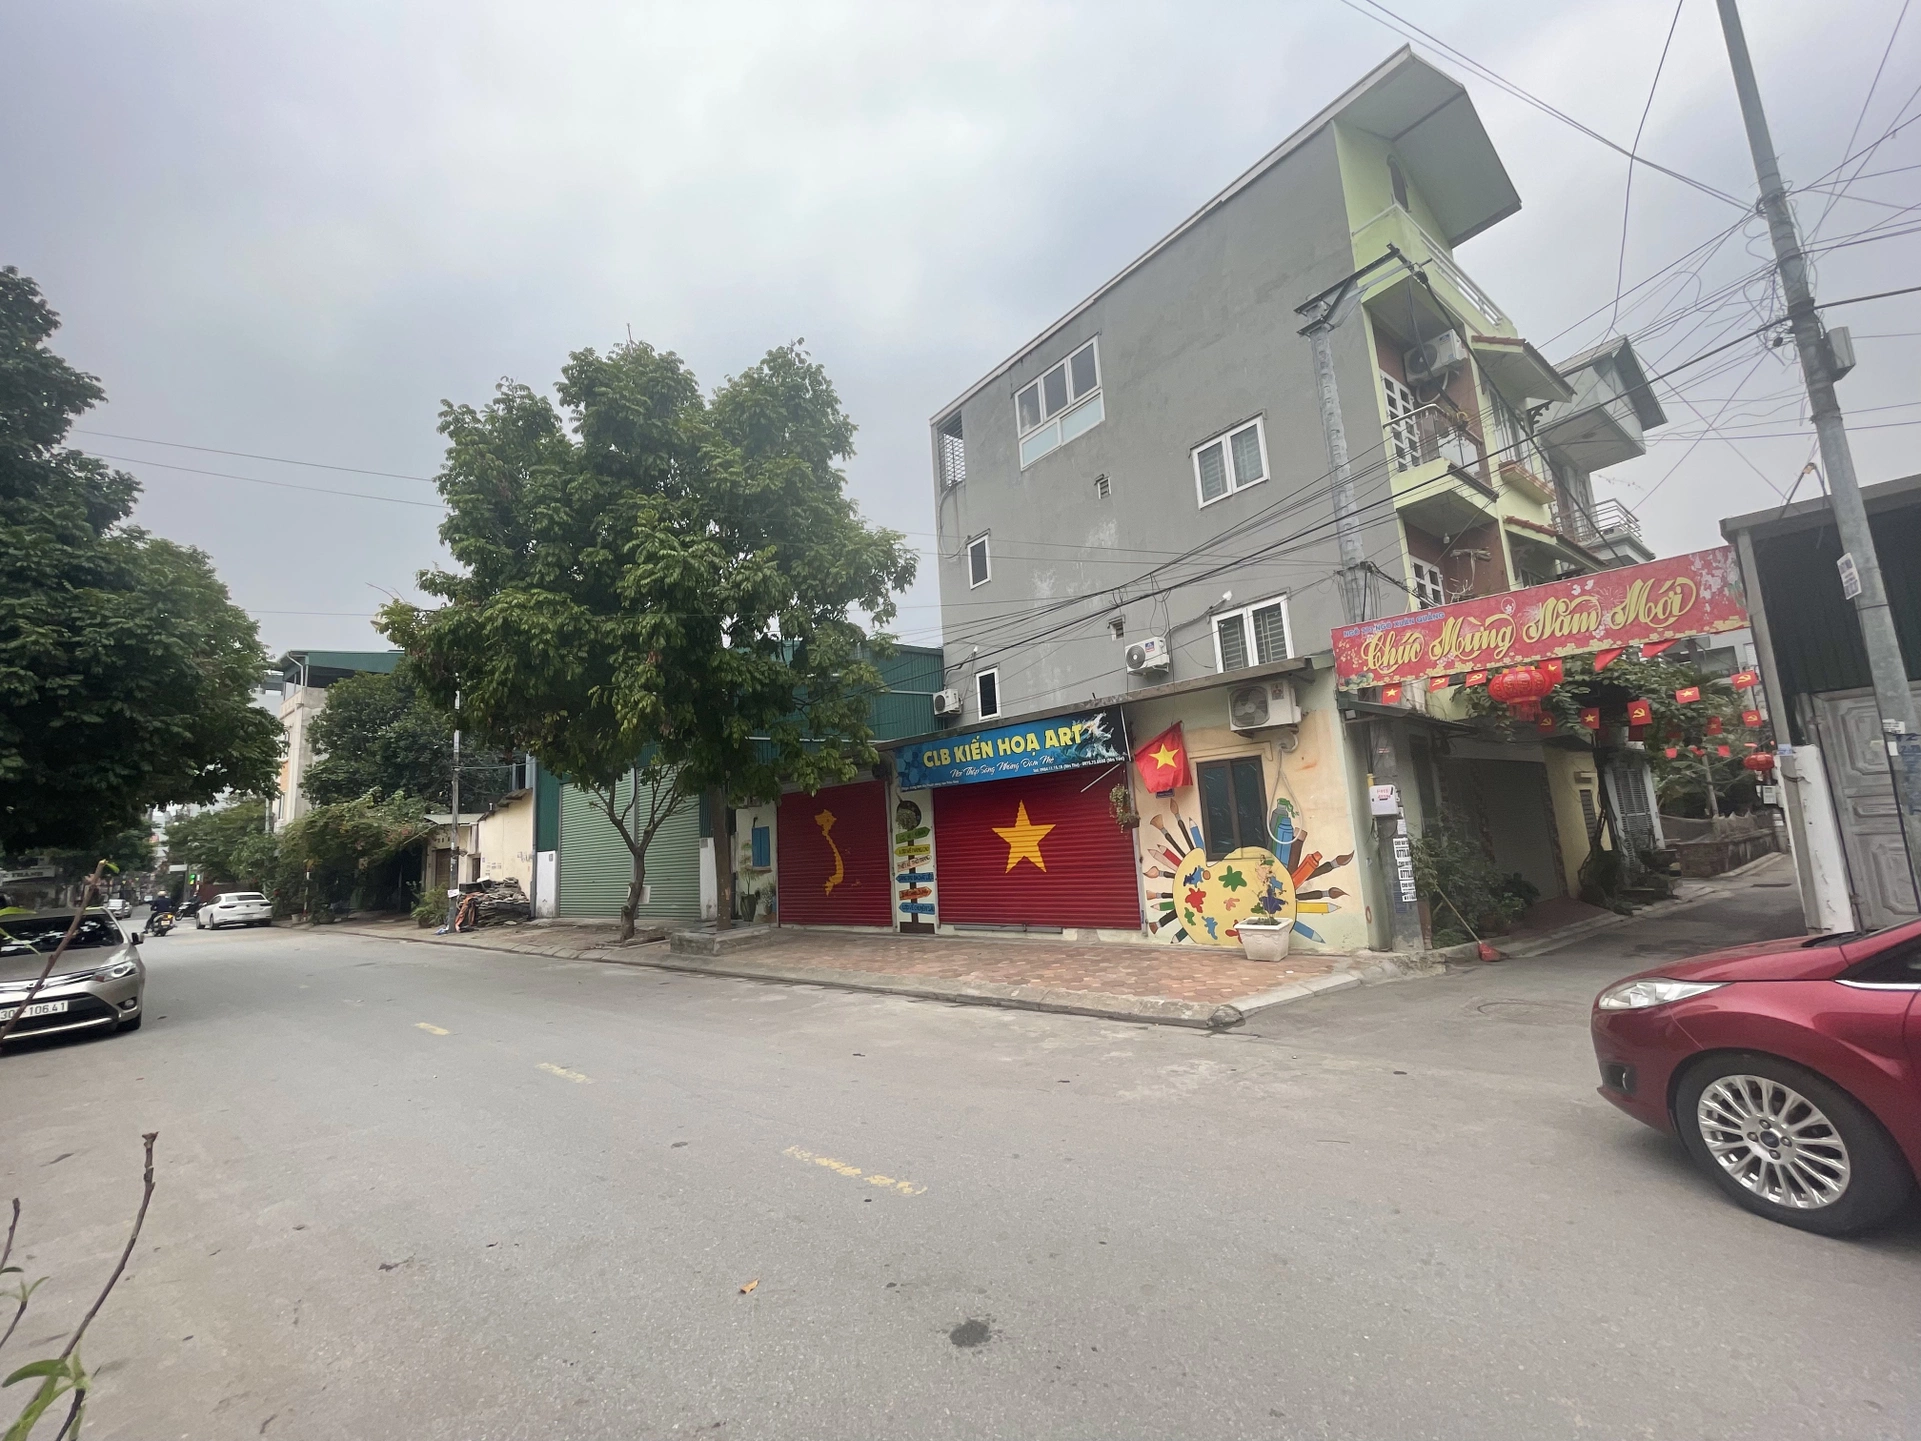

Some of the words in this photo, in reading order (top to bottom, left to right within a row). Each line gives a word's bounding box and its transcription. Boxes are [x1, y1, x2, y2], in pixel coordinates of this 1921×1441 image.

[1360, 630, 1425, 675] Chúc
[1609, 576, 1697, 630] Mới
[923, 748, 951, 768] CLB
[953, 735, 994, 763] KIẾN
[997, 732, 1041, 756] HOẠ
[1044, 723, 1083, 749] ART
[0, 1002, 65, 1020] 30-106.41
